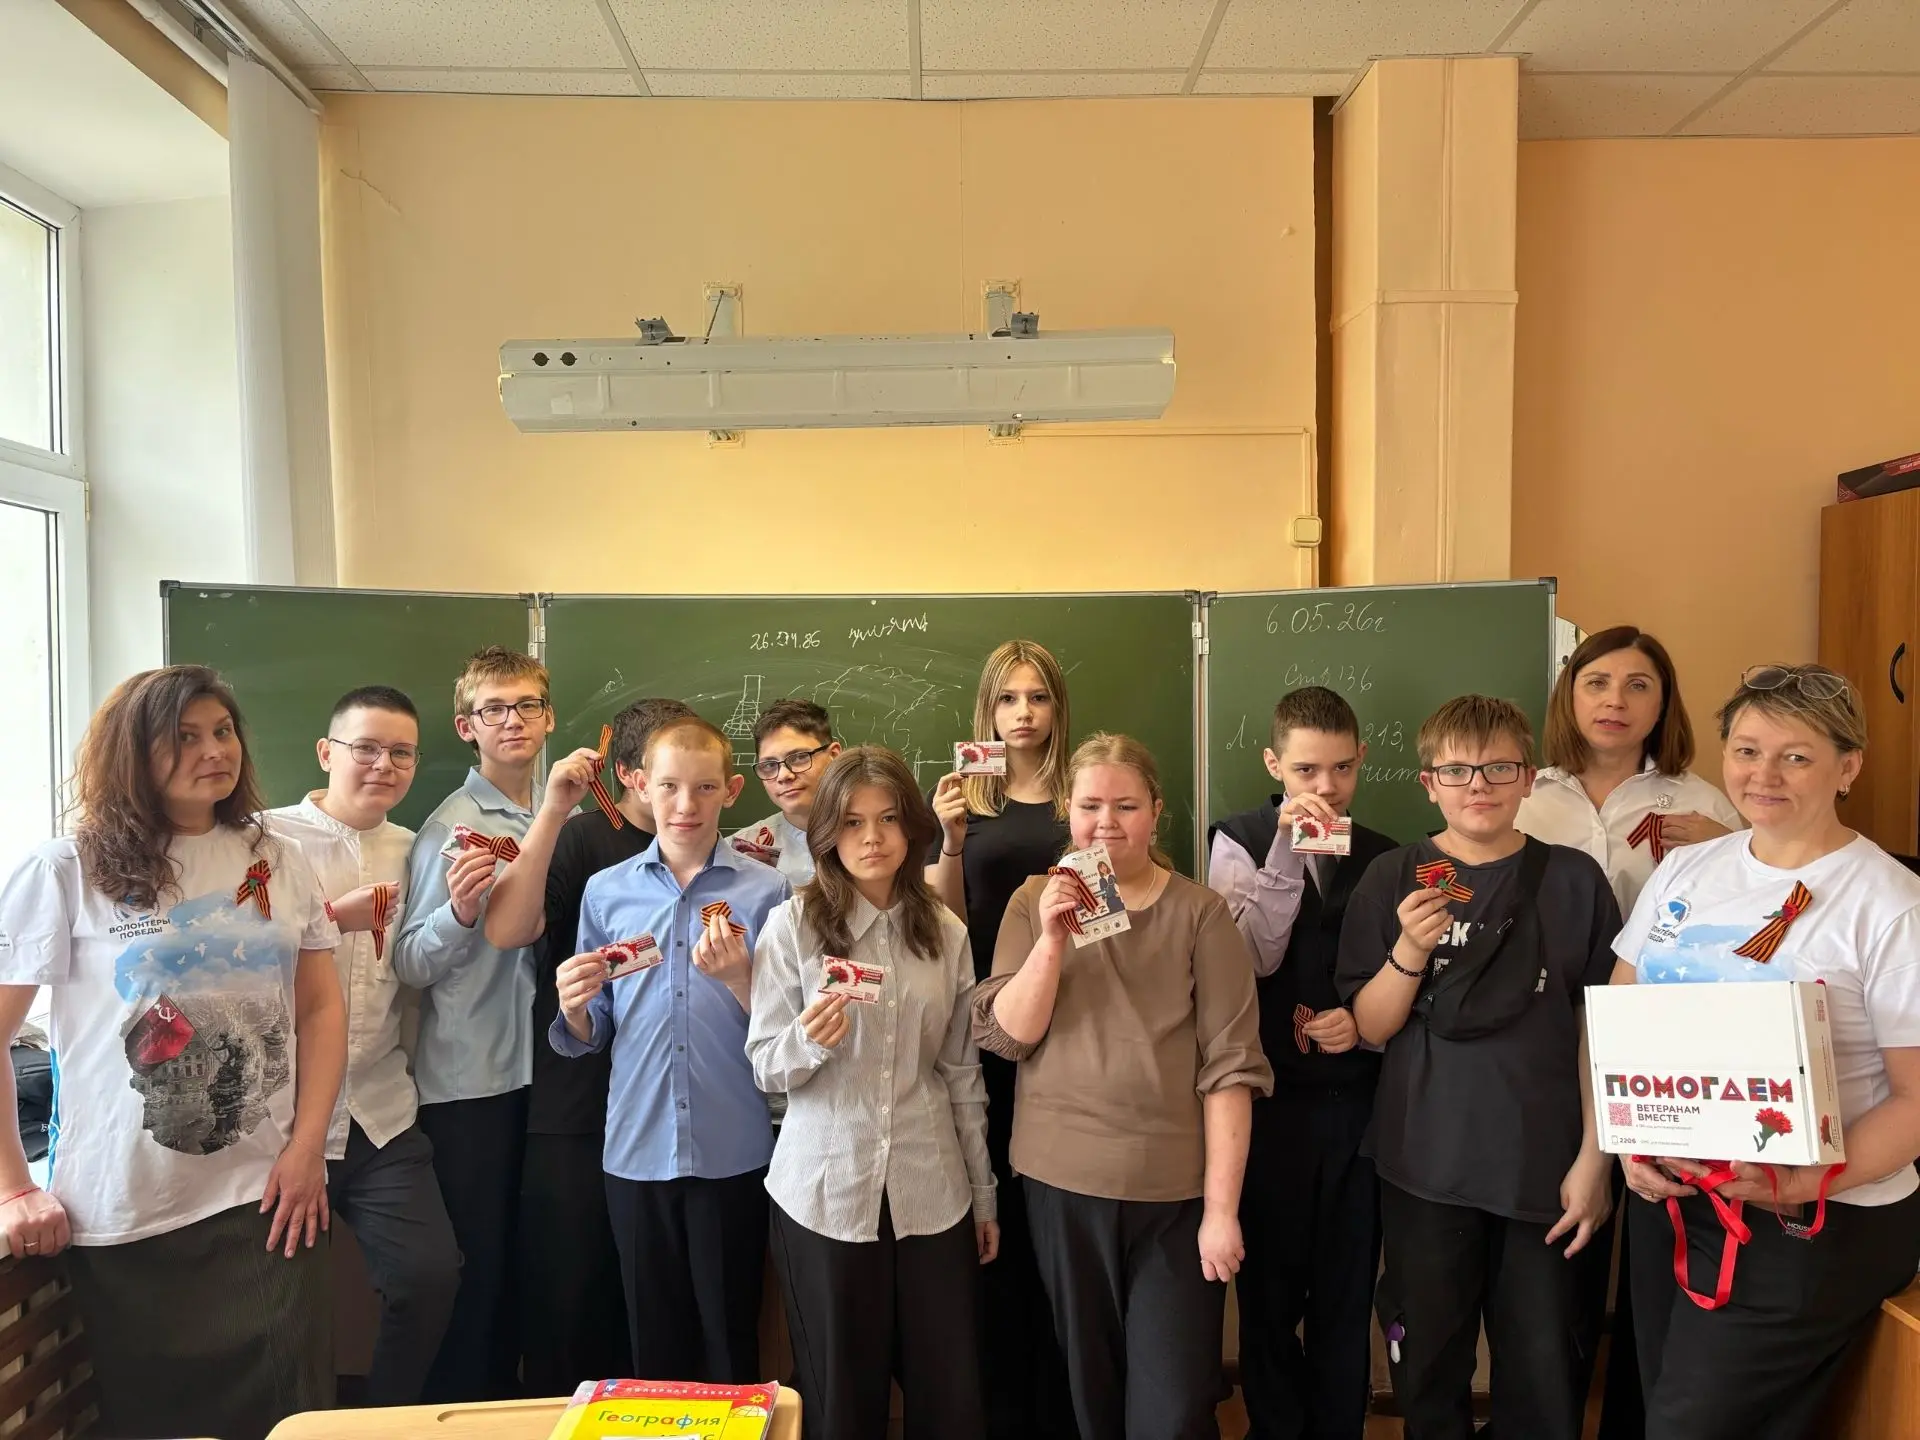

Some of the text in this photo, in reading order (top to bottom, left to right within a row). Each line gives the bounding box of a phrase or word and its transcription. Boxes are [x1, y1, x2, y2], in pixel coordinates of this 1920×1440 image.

[120, 926, 163, 940] ПОБЕДЫ
[1605, 1074, 1794, 1102] ПОМОГАЕМ
[1636, 1104, 1700, 1114] ВЕТЕРАНАМ
[1638, 1113, 1680, 1123] ВМЕСТЕ
[598, 1410, 721, 1430] География
